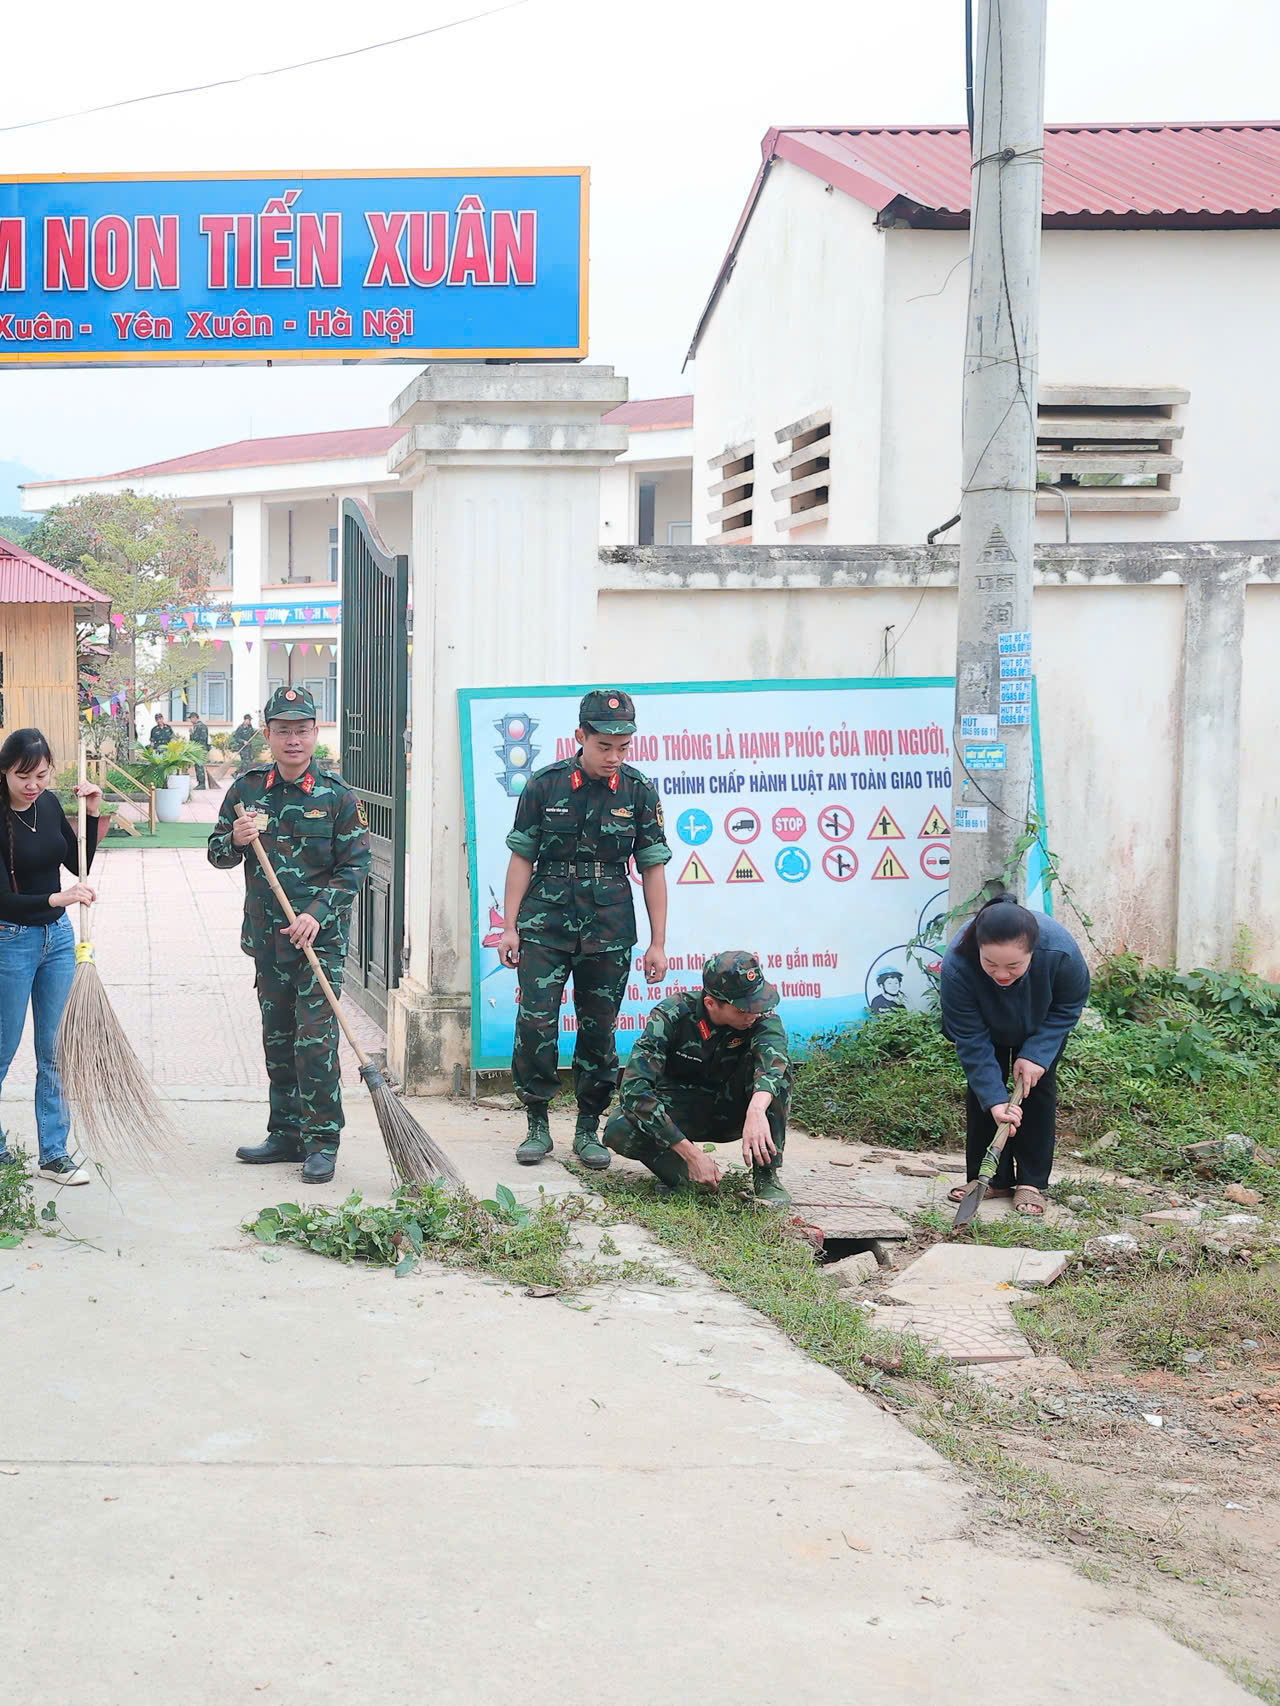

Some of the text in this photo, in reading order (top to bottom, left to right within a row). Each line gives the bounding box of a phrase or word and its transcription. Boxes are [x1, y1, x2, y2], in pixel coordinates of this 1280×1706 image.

[43, 214, 181, 292] NON
[200, 189, 343, 290] TIẾN
[364, 194, 538, 288] XUÂN
[112, 310, 173, 340] Yên
[186, 311, 273, 339] Xuân
[308, 308, 351, 337] Hà
[364, 308, 414, 344] Nội
[556, 720, 950, 765] AN GIAO THÔNG LÀ HẠNH PHÚC CỦA MỌI NGƯỜI,
[663, 771, 705, 795] CHỈNH
[709, 768, 745, 794] CHẤP
[750, 771, 787, 793] HÀNH
[791, 769, 823, 795] LUẬT
[828, 772, 847, 791] AN
[850, 768, 886, 791] TOÀN
[891, 771, 922, 790] GIAO
[926, 767, 952, 789] THÔ
[775, 818, 802, 832] STOP
[767, 953, 782, 969] xe
[786, 947, 809, 971] gắn
[812, 950, 838, 970] máy
[627, 984, 643, 1002] tô,
[647, 988, 661, 1000] xe
